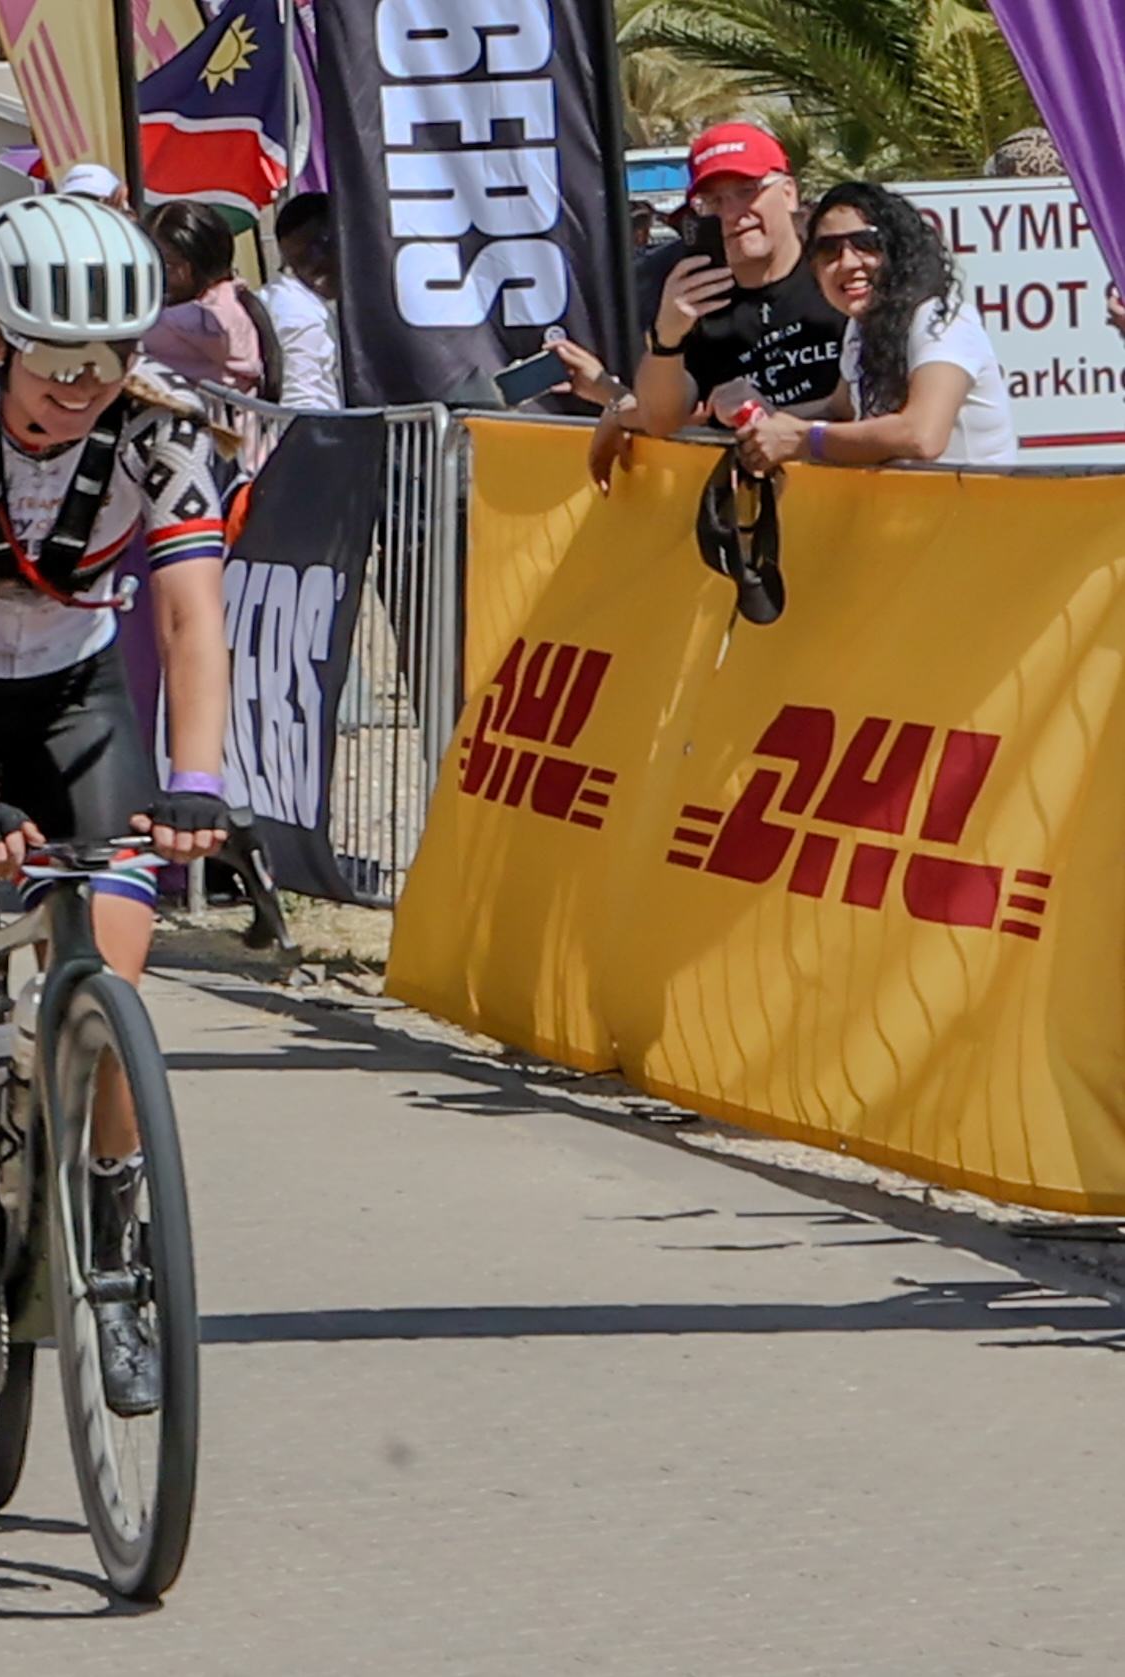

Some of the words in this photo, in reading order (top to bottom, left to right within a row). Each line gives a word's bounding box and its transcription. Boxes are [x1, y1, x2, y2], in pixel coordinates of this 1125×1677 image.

[976, 280, 1088, 332] HOT
[999, 356, 1125, 404] arkin
[706, 704, 1004, 928] DHL
